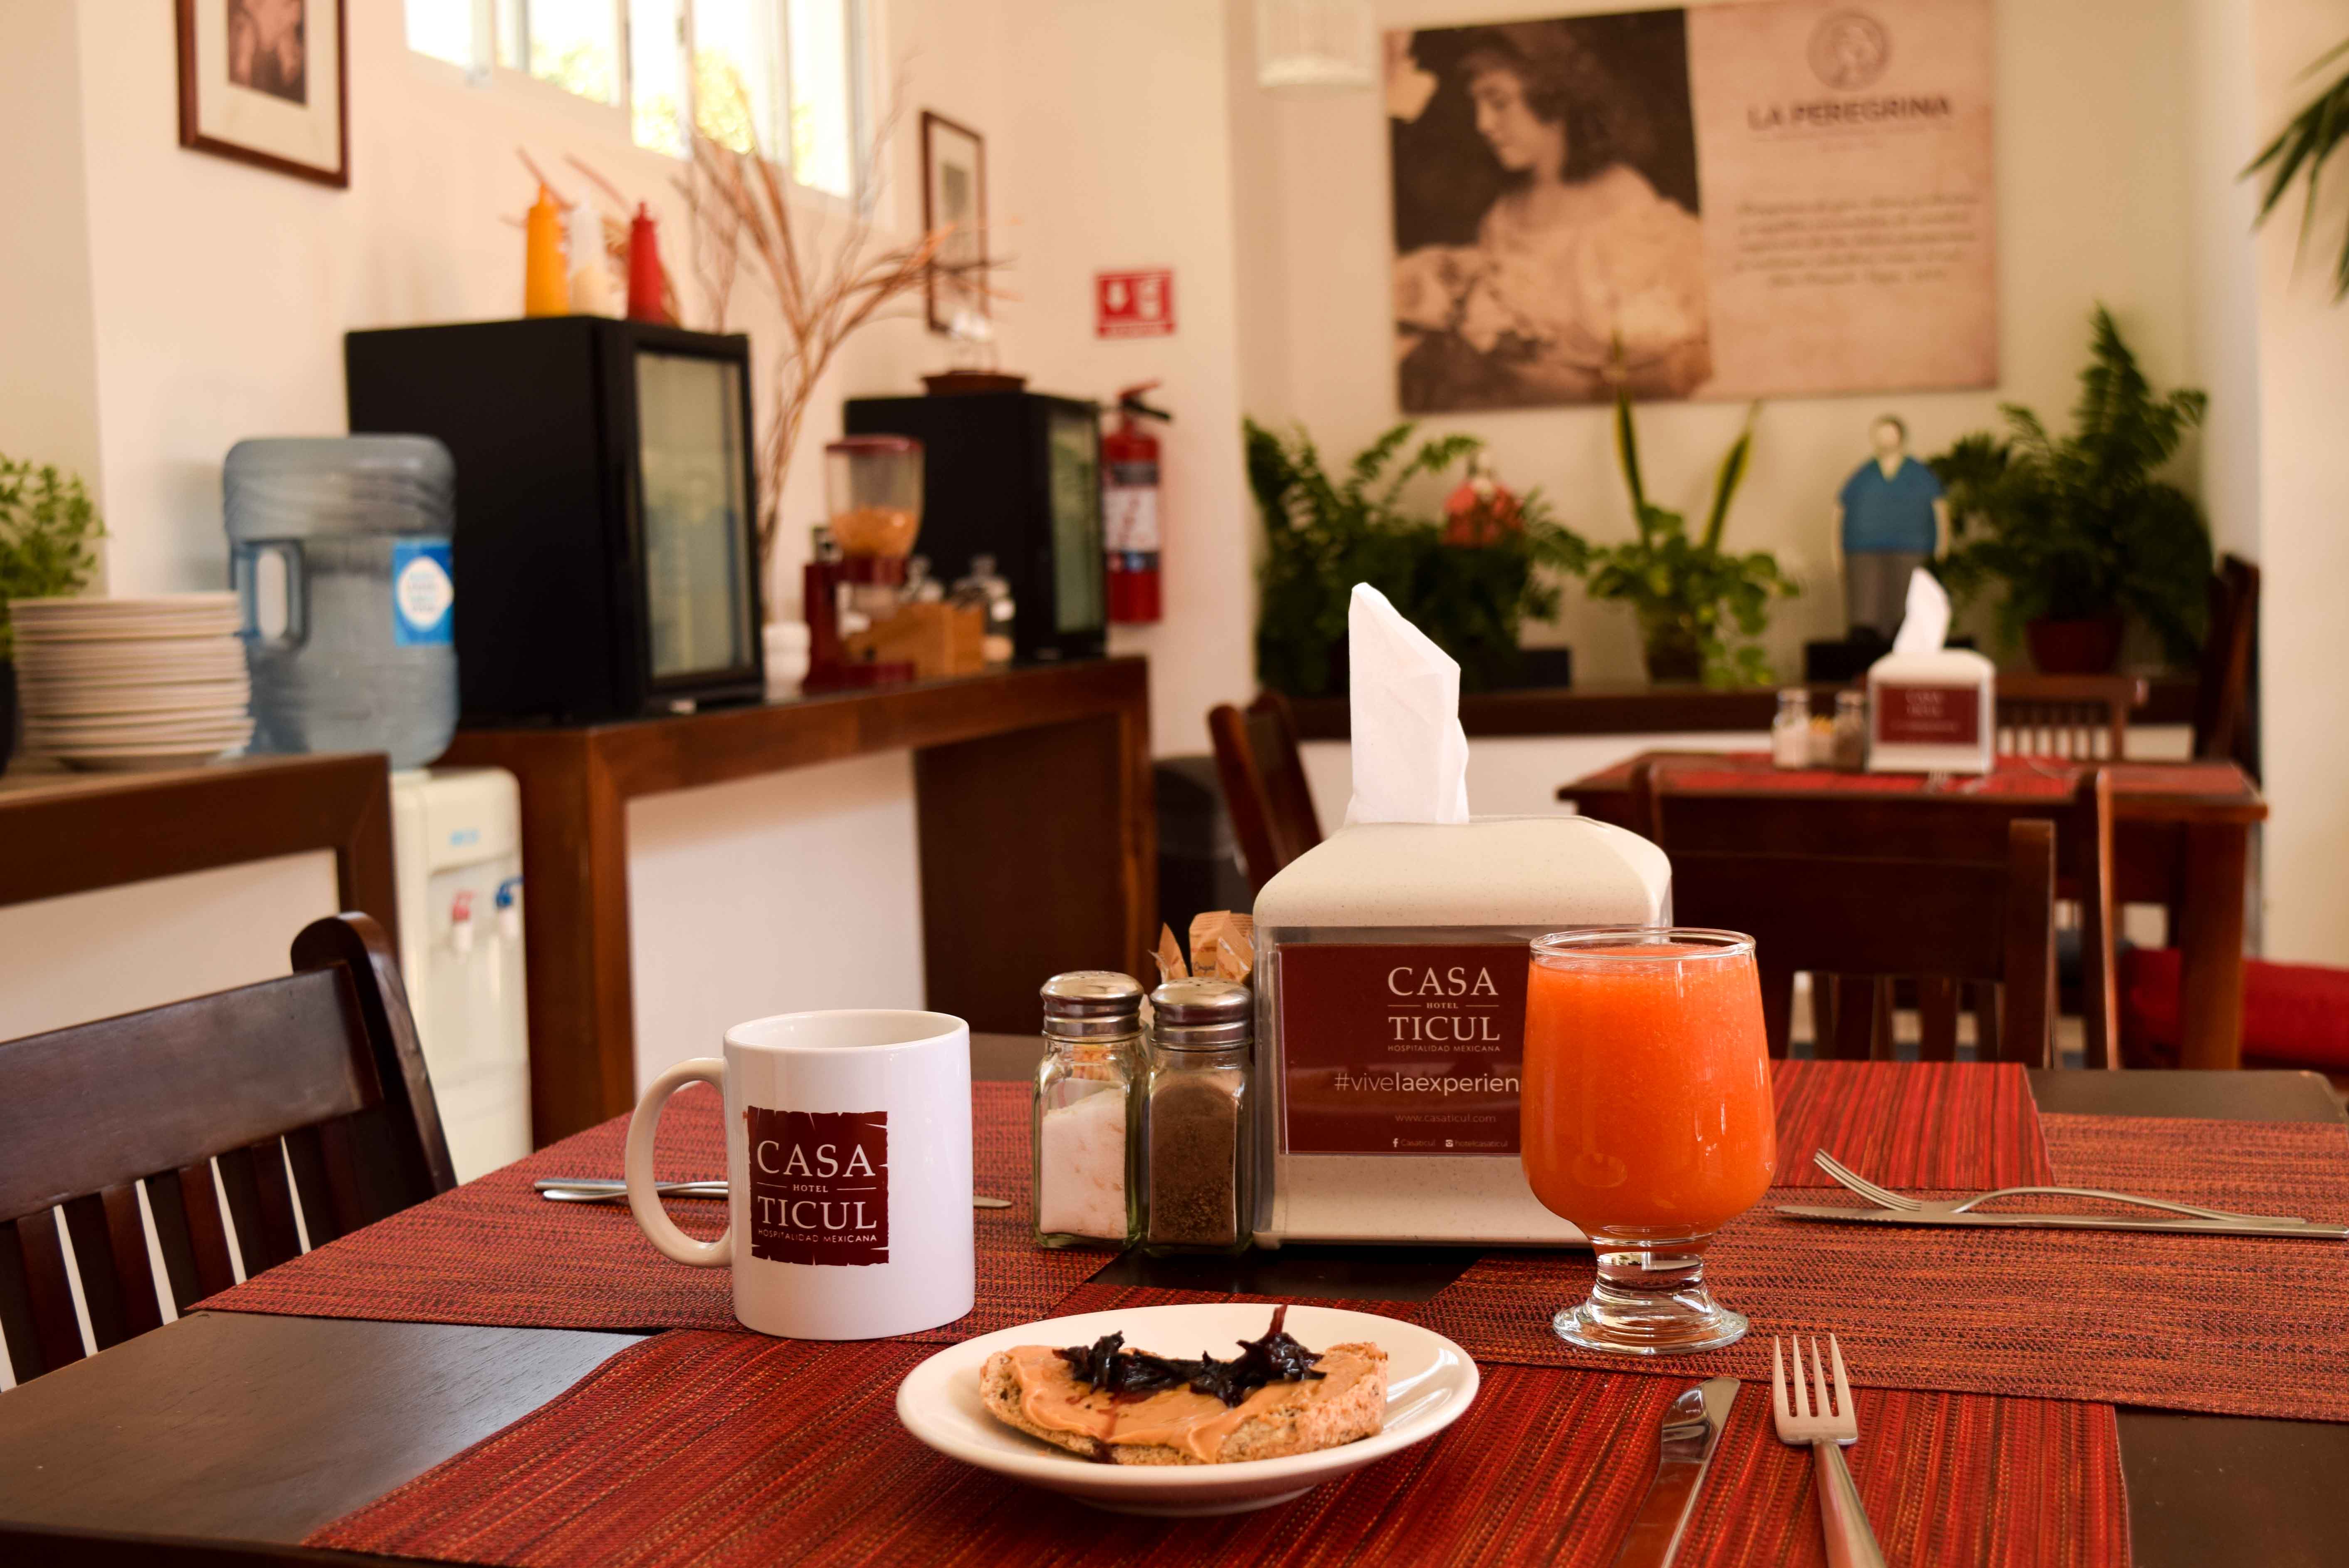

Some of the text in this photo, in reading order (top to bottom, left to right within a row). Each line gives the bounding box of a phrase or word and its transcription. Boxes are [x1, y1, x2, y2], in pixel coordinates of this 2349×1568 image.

[1747, 96, 1949, 130] LA PEREGRINA
[1388, 967, 1499, 996] CASA
[1388, 1016, 1500, 1041] TICUL
[1334, 1072, 1519, 1096] #vivelaexperien
[1395, 1114, 1497, 1123] www.casaticul.com
[757, 1140, 876, 1178] CASA
[793, 1184, 829, 1193] HOTEL
[757, 1195, 877, 1230] TICUL
[758, 1229, 877, 1243] HOSPITALIDAD MEXICANA
